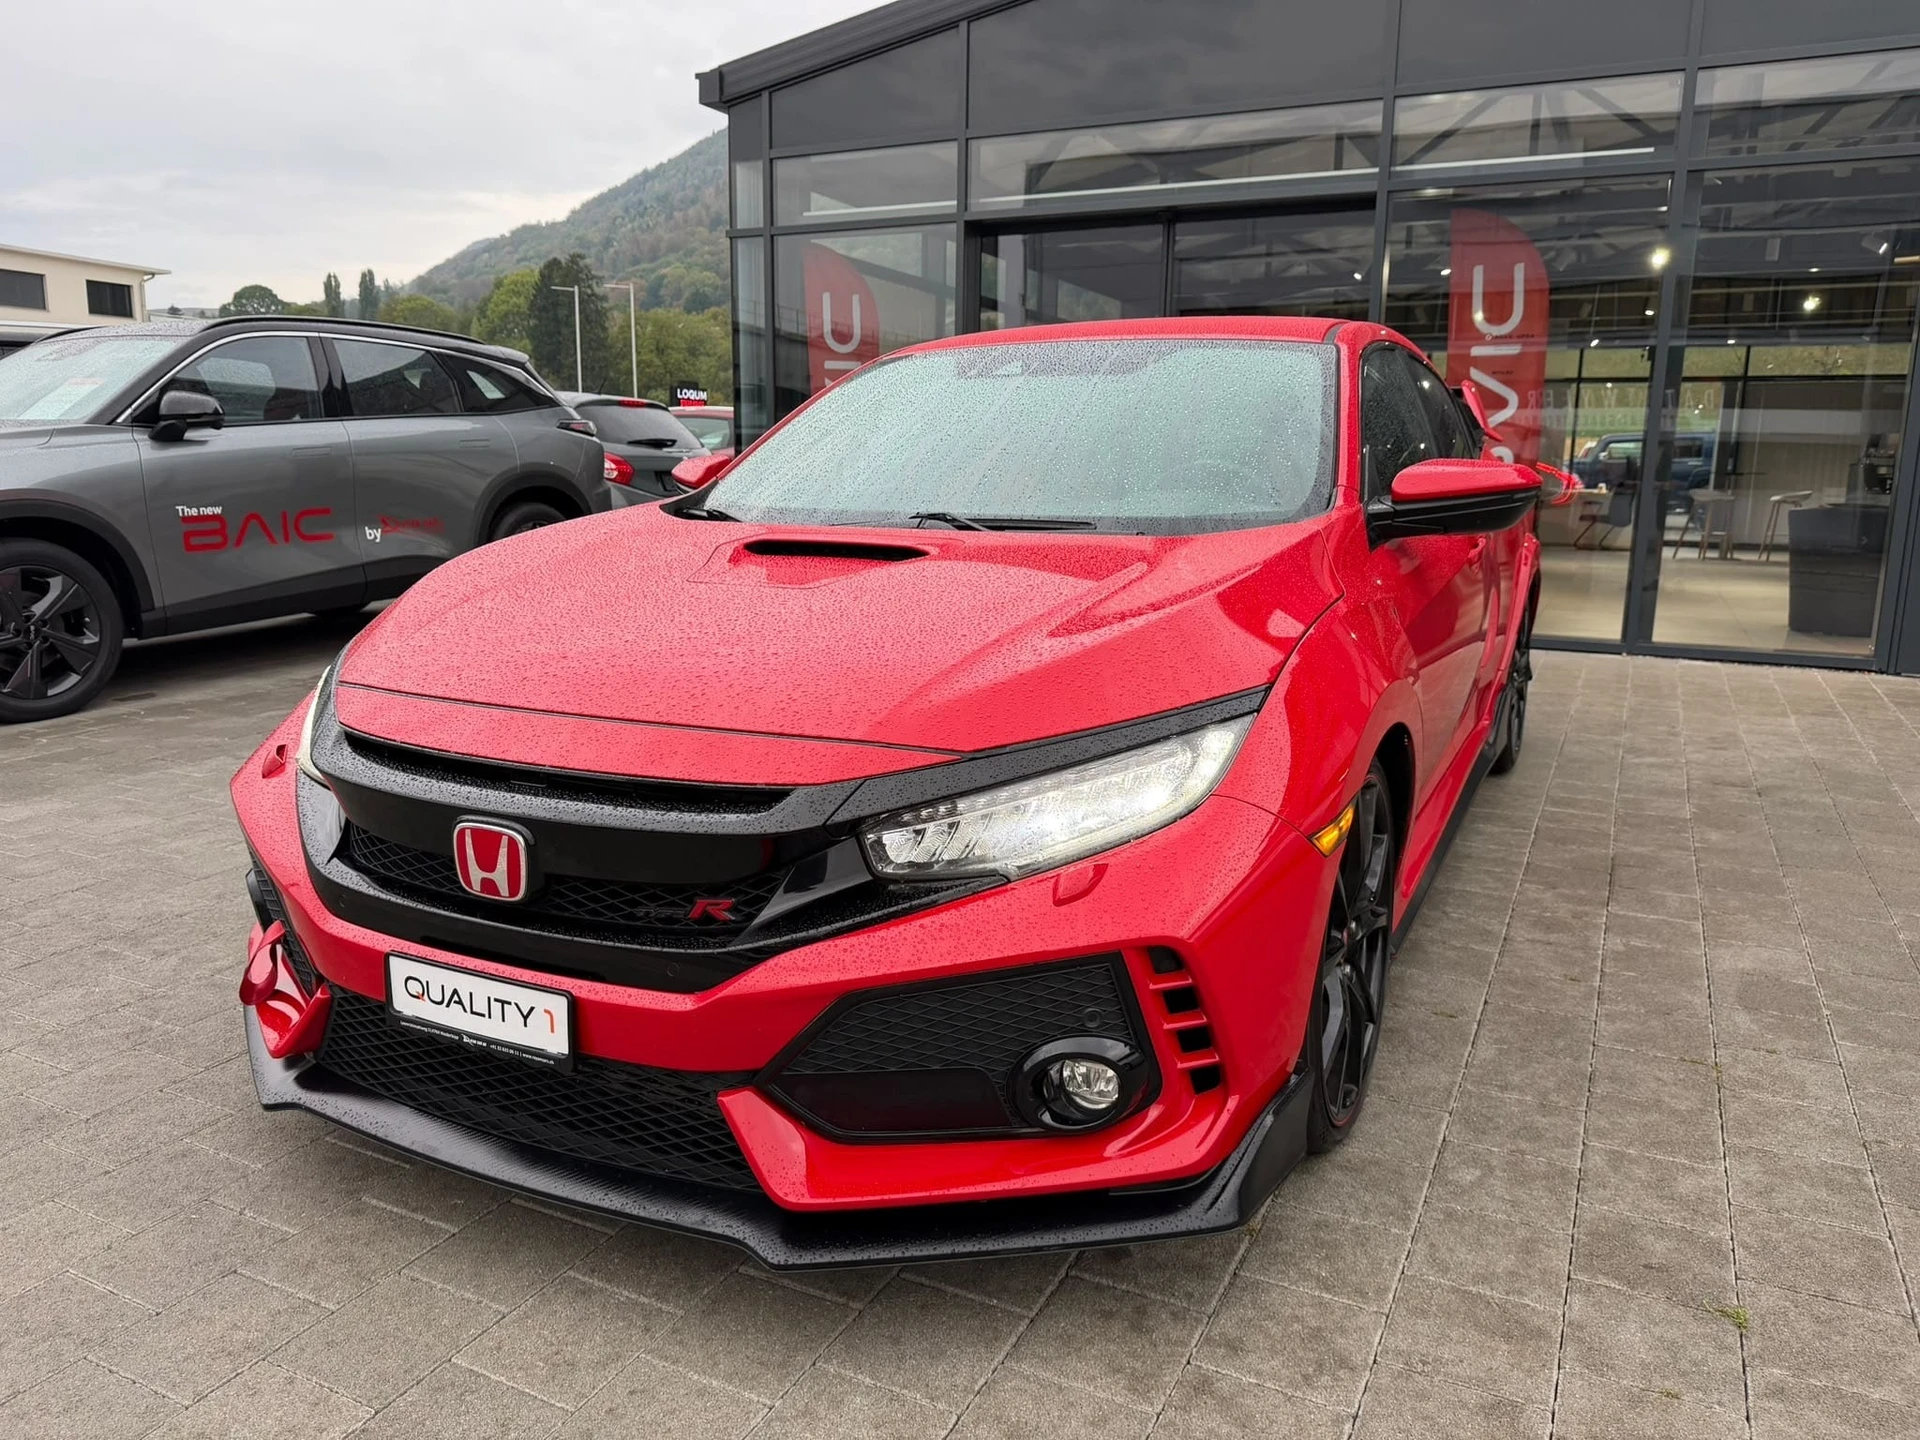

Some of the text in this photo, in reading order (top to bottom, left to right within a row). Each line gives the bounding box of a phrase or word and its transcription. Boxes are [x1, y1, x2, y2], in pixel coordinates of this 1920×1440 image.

[176, 505, 222, 517] The new
[181, 507, 335, 553] BAIC
[365, 526, 382, 542] by
[688, 898, 735, 921] R
